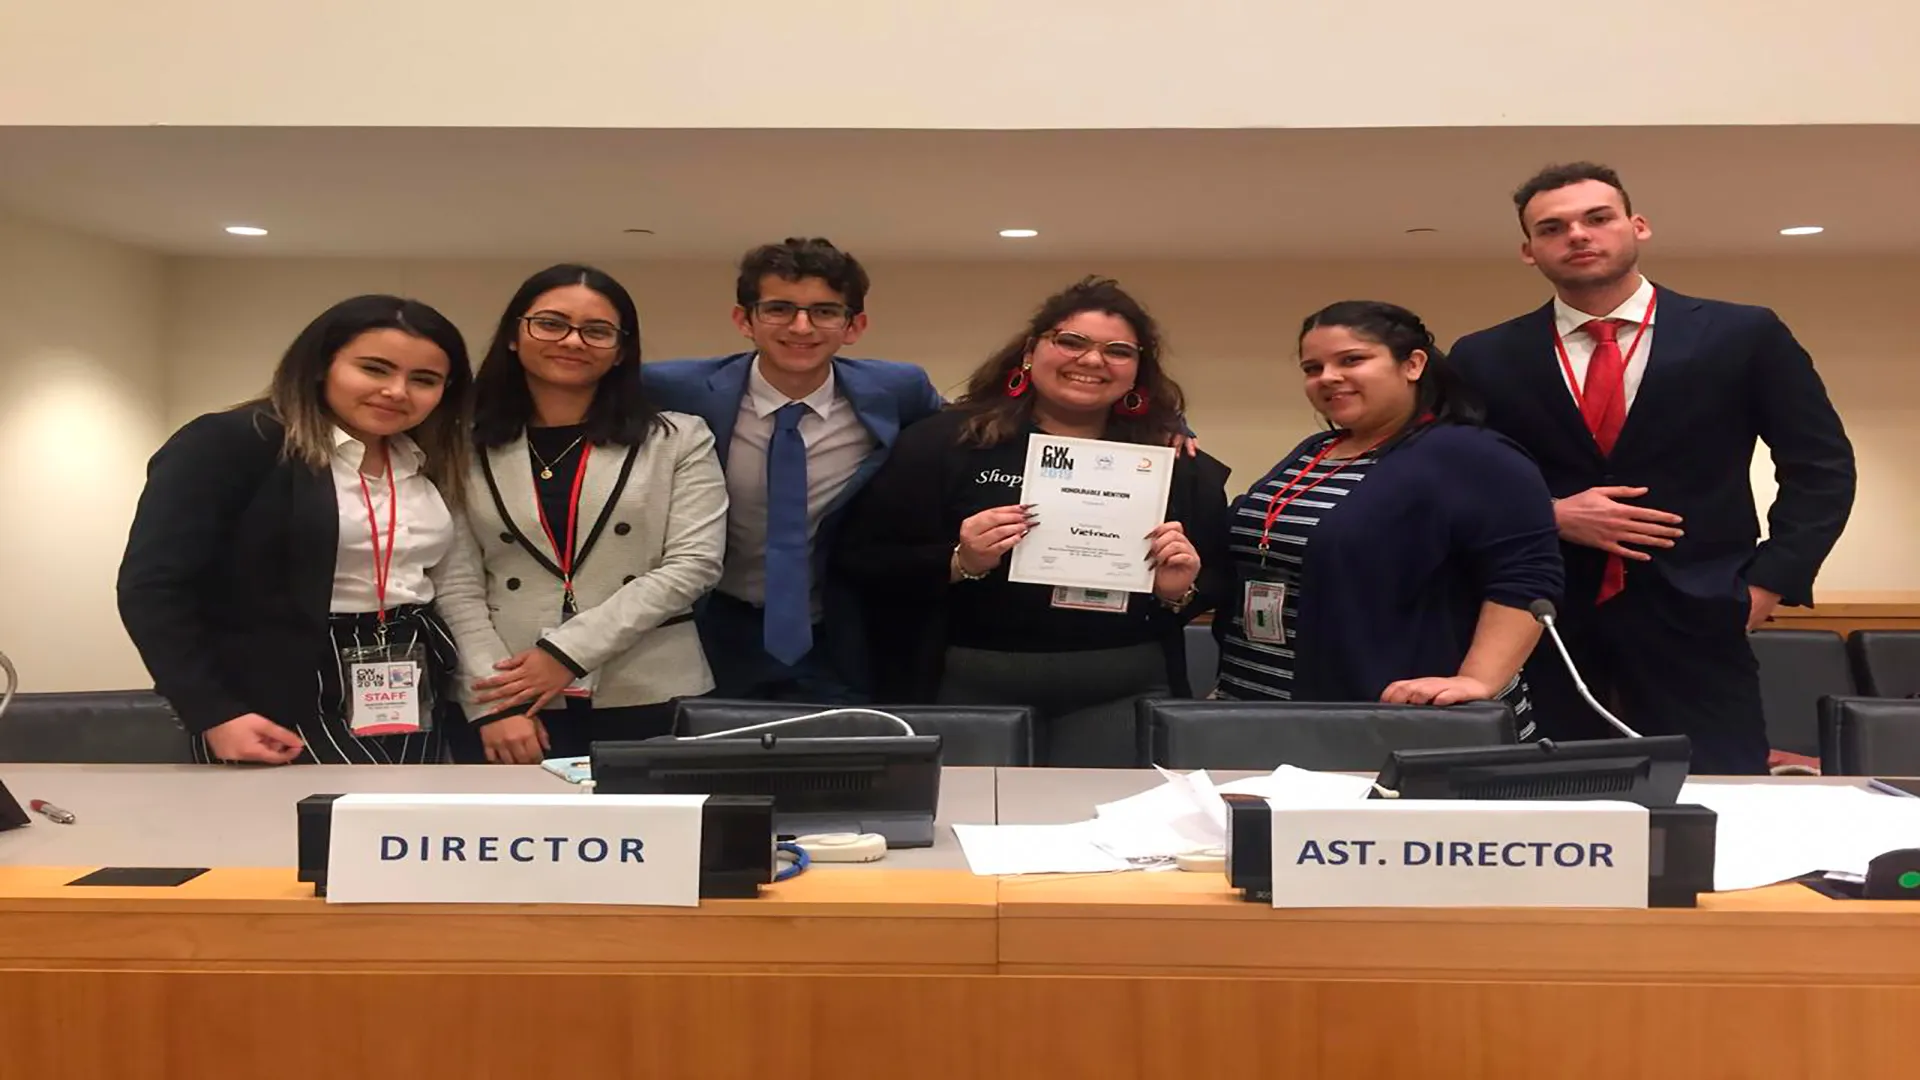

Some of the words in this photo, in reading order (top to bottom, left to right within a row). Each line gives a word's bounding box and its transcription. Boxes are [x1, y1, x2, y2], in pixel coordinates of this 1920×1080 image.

[1043, 445, 1069, 459] CW
[1041, 456, 1074, 470] MUN
[975, 468, 1023, 488] Shop
[1061, 486, 1101, 496] HONOURABLE
[1103, 490, 1130, 499] MENTION
[1070, 526, 1120, 539] Vietnam
[356, 668, 375, 676] CW
[357, 680, 384, 688] 2019
[364, 692, 407, 702] STAFF
[380, 835, 645, 863] DIRECTOR
[1296, 840, 1387, 865] AST.
[1403, 841, 1614, 867] DIRECTOR
